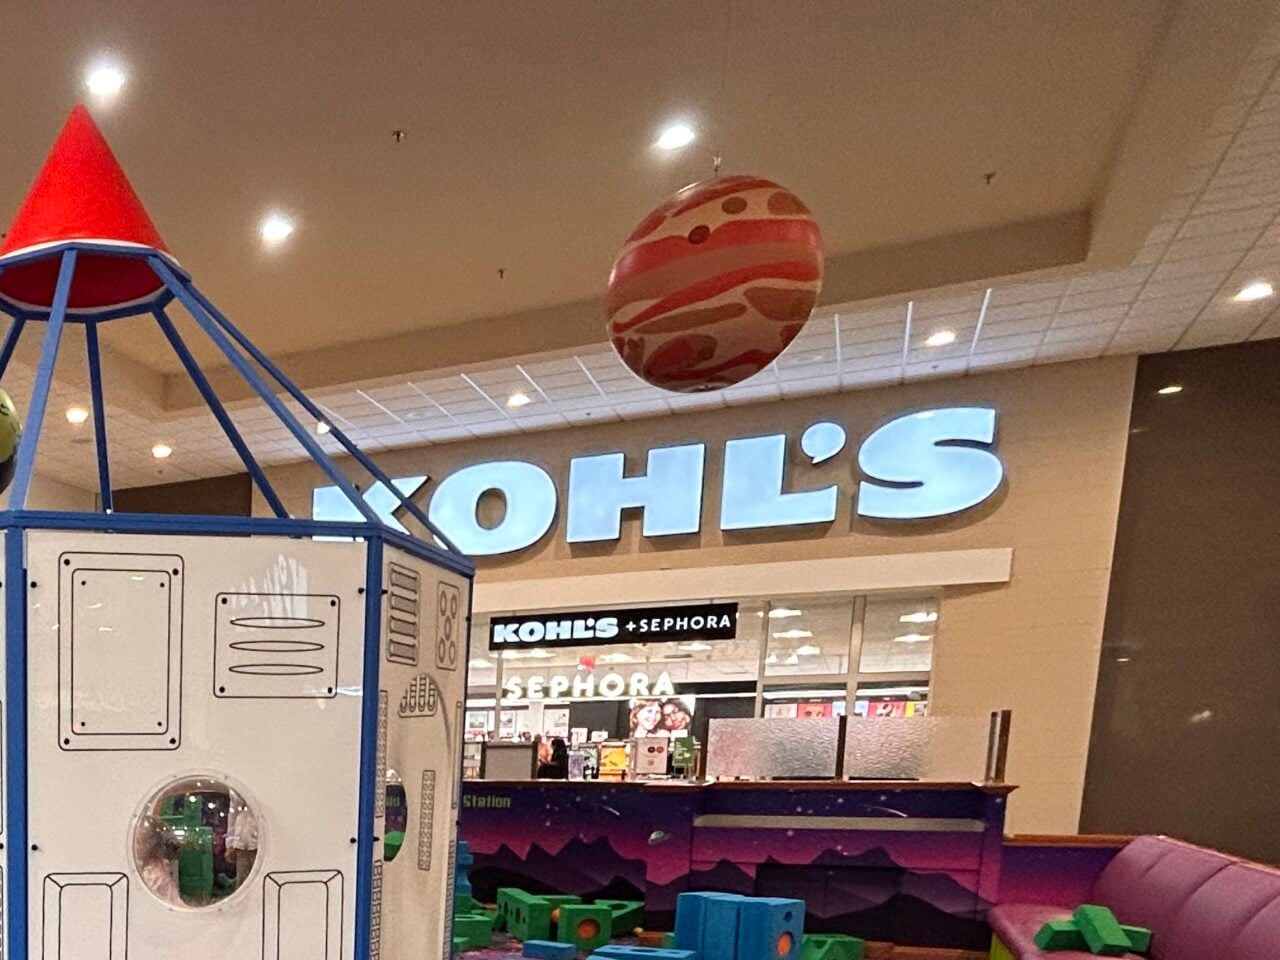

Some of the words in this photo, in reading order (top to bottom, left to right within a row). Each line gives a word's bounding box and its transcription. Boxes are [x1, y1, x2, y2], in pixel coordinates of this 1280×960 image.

[312, 407, 1004, 556] KOHL'S
[493, 617, 620, 643] KOHL'S
[504, 672, 675, 699] SEPHORA
[463, 794, 511, 808] Station
